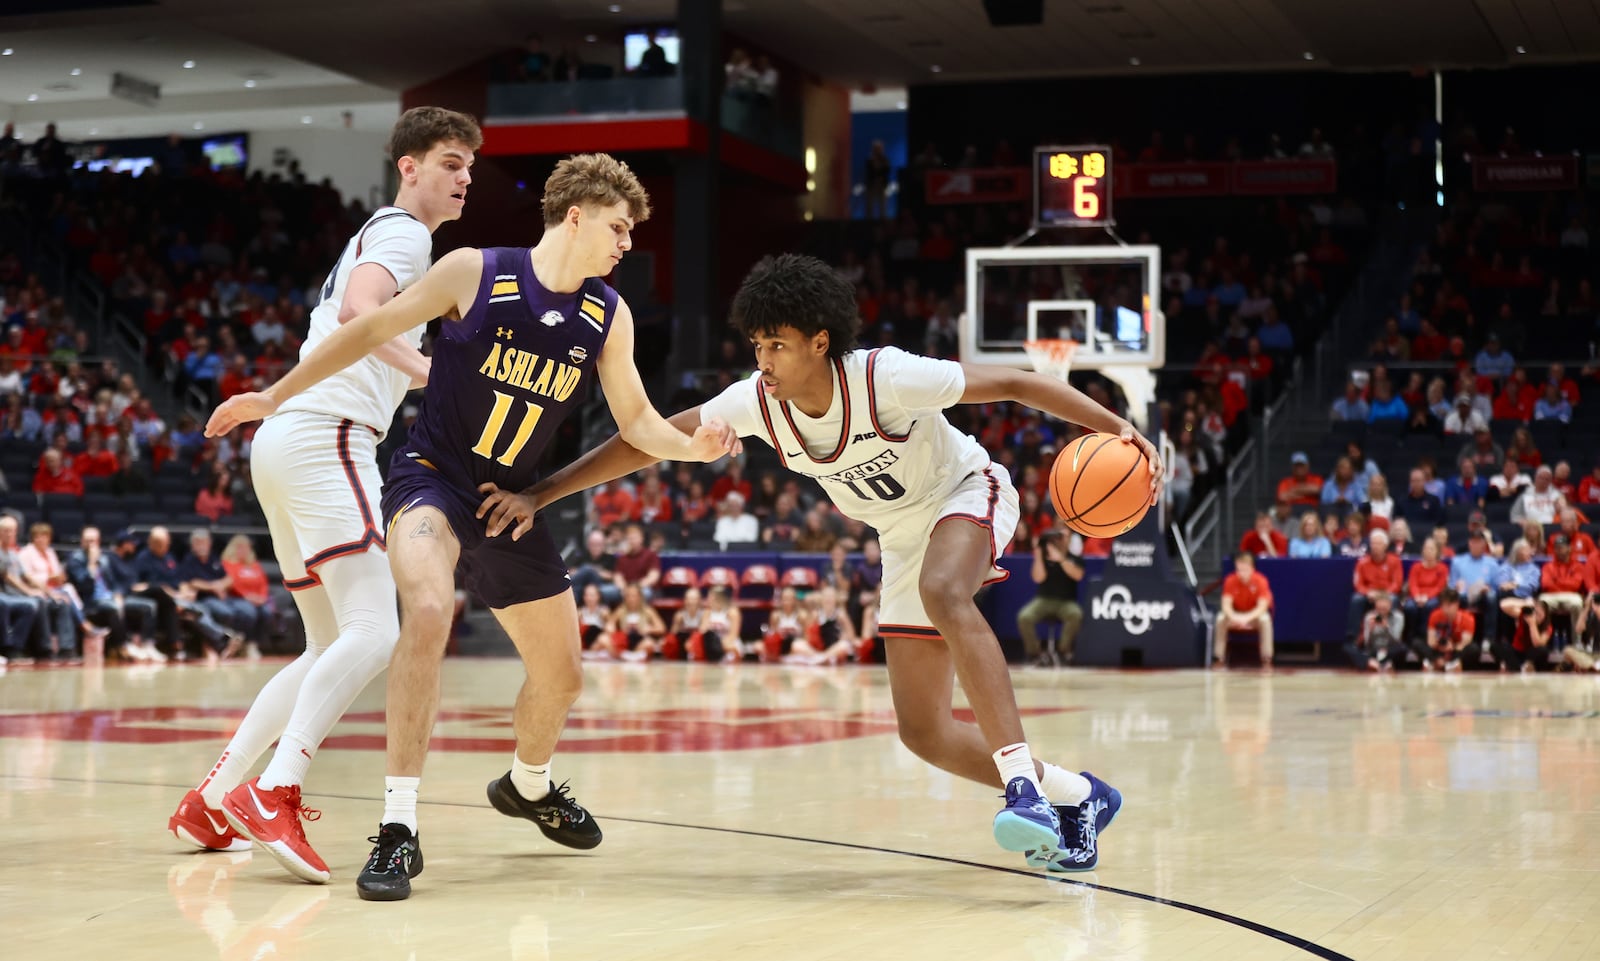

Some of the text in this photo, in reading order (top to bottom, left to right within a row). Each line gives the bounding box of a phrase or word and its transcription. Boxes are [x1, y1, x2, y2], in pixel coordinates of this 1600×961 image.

[1074, 176, 1099, 217] 6
[479, 342, 581, 403] ASHLAND
[471, 389, 544, 467] 11
[852, 432, 877, 445] A10
[800, 448, 899, 483] YTON
[842, 473, 906, 501] 10
[1115, 554, 1153, 567] Health
[1092, 584, 1175, 635] Kroger
